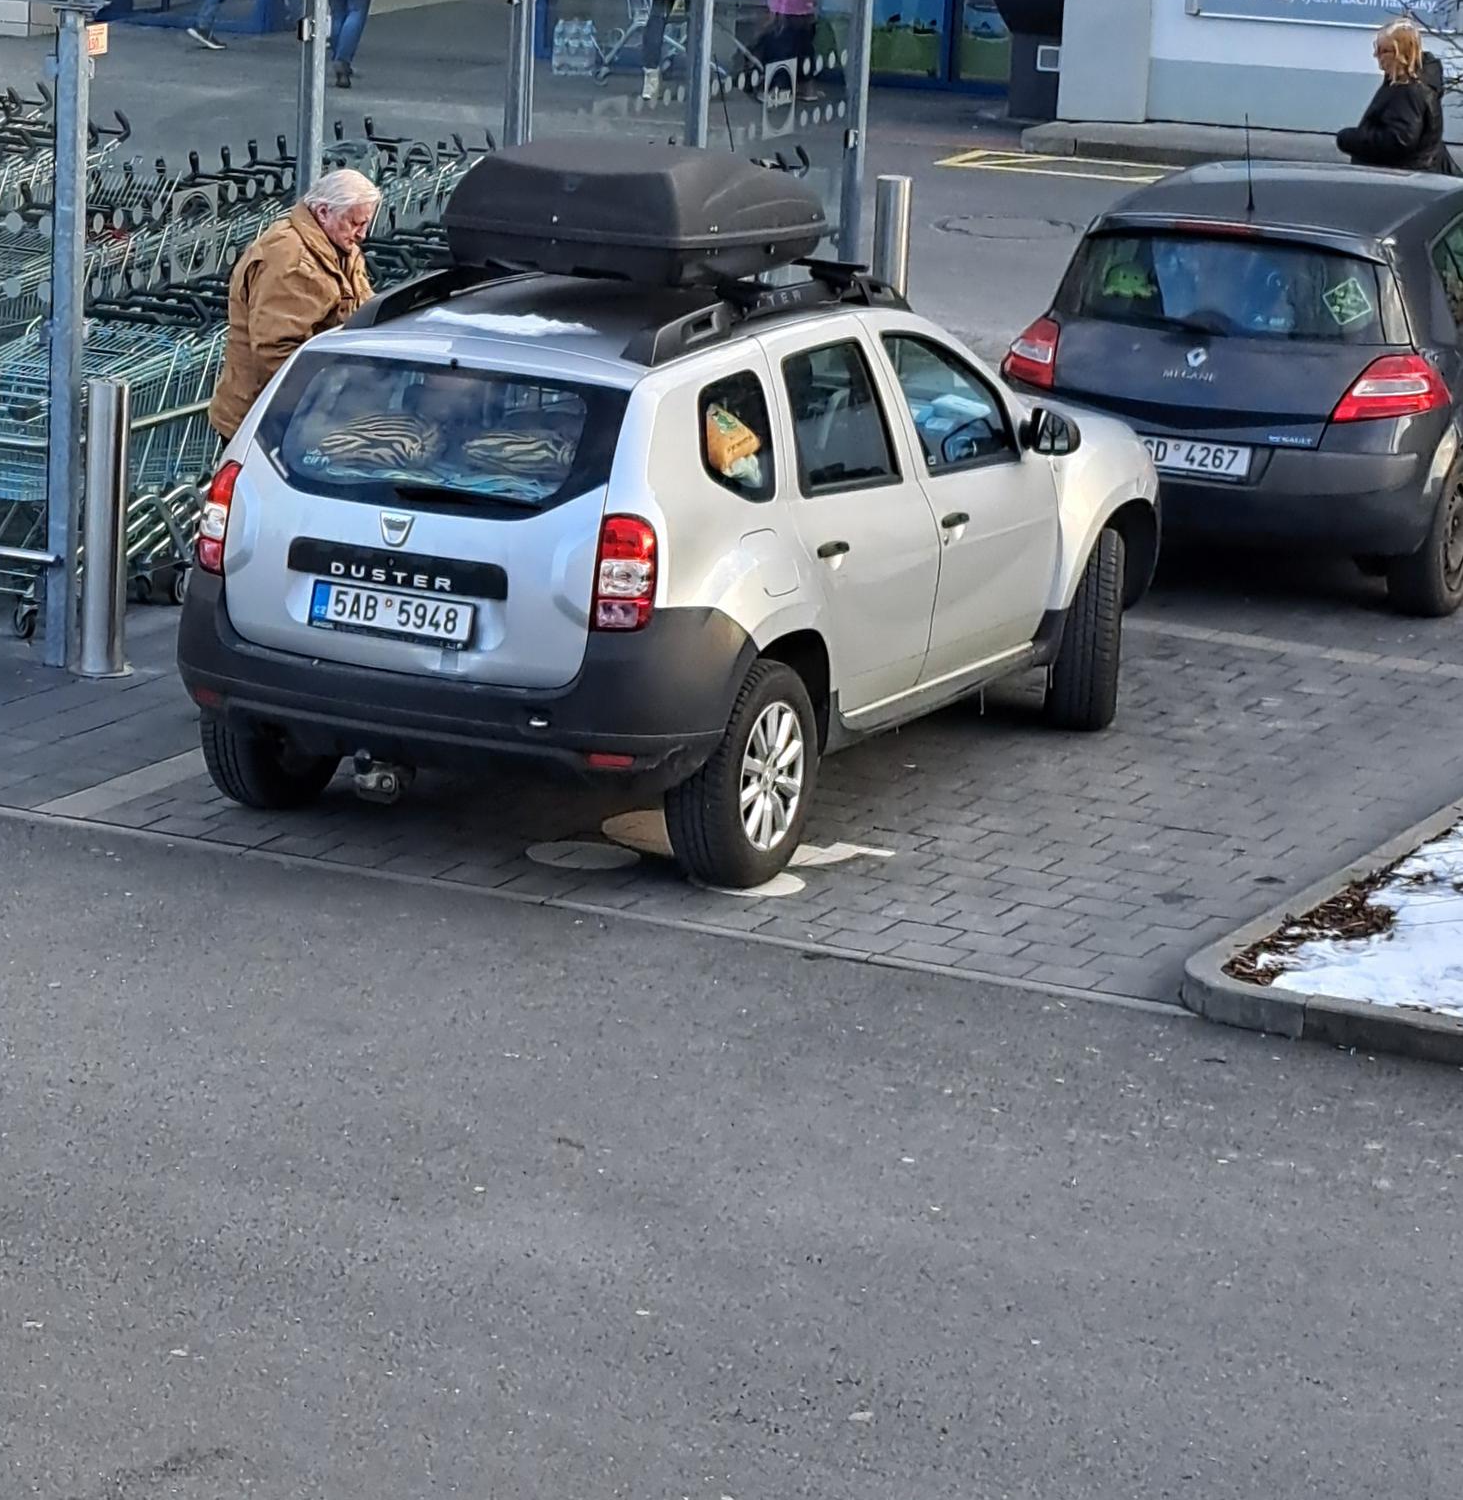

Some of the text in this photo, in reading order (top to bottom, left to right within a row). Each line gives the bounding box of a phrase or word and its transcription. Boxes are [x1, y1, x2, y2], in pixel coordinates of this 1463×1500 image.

[1184, 444, 1240, 472] 4267
[330, 561, 452, 592] DUSTER
[333, 590, 458, 635] 5AB 5948
